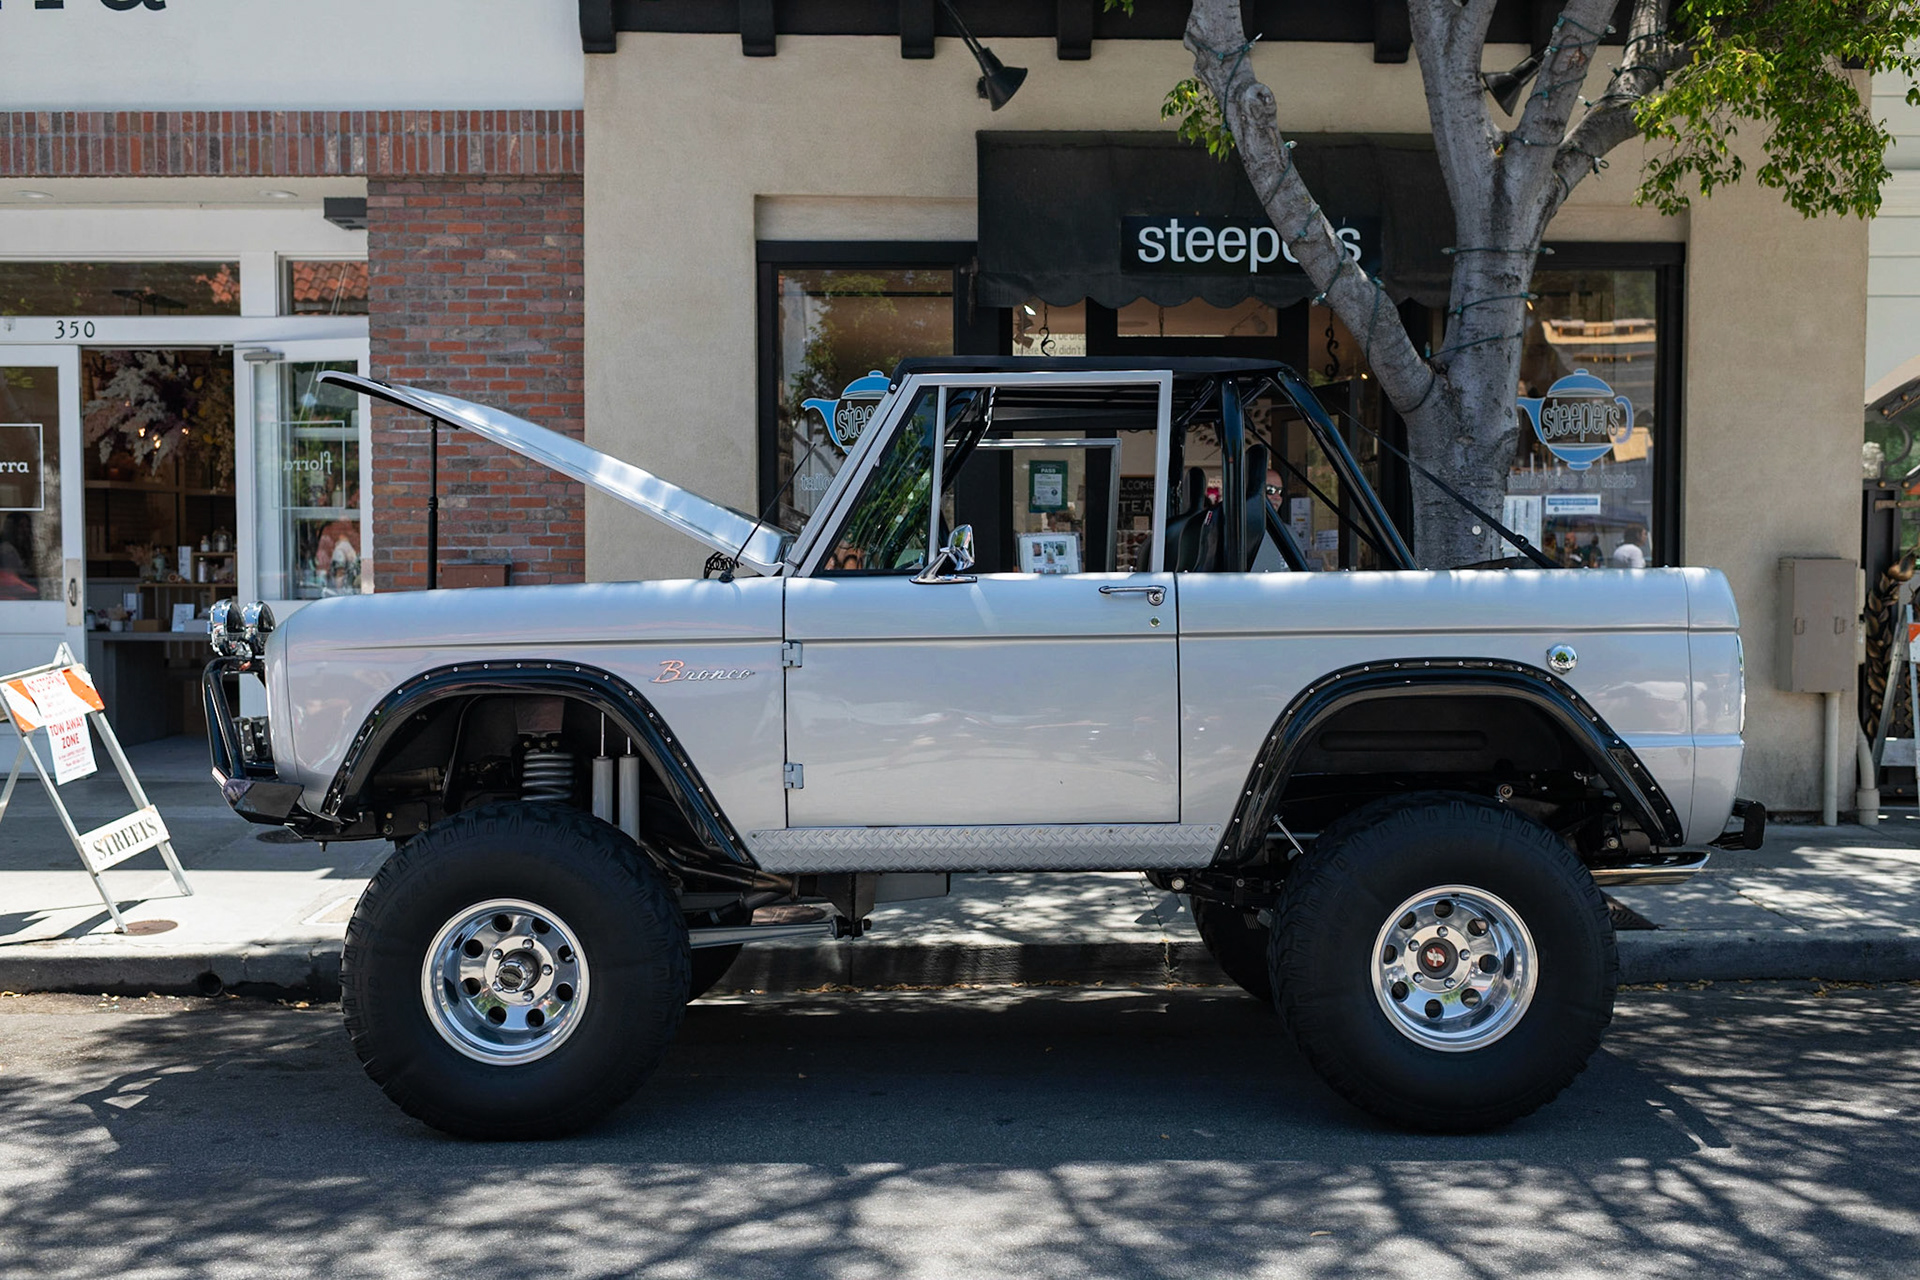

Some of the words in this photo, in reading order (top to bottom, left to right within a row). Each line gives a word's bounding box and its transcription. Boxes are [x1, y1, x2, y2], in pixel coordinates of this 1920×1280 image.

[1137, 218, 1362, 273] steeps
[54, 319, 95, 339] 350
[1542, 399, 1620, 442] steepers
[648, 659, 756, 684] Bronco
[49, 722, 65, 736] TOW
[65, 716, 84, 731] AWAY
[61, 732, 80, 749] ZONE
[92, 817, 158, 861] STREETS
